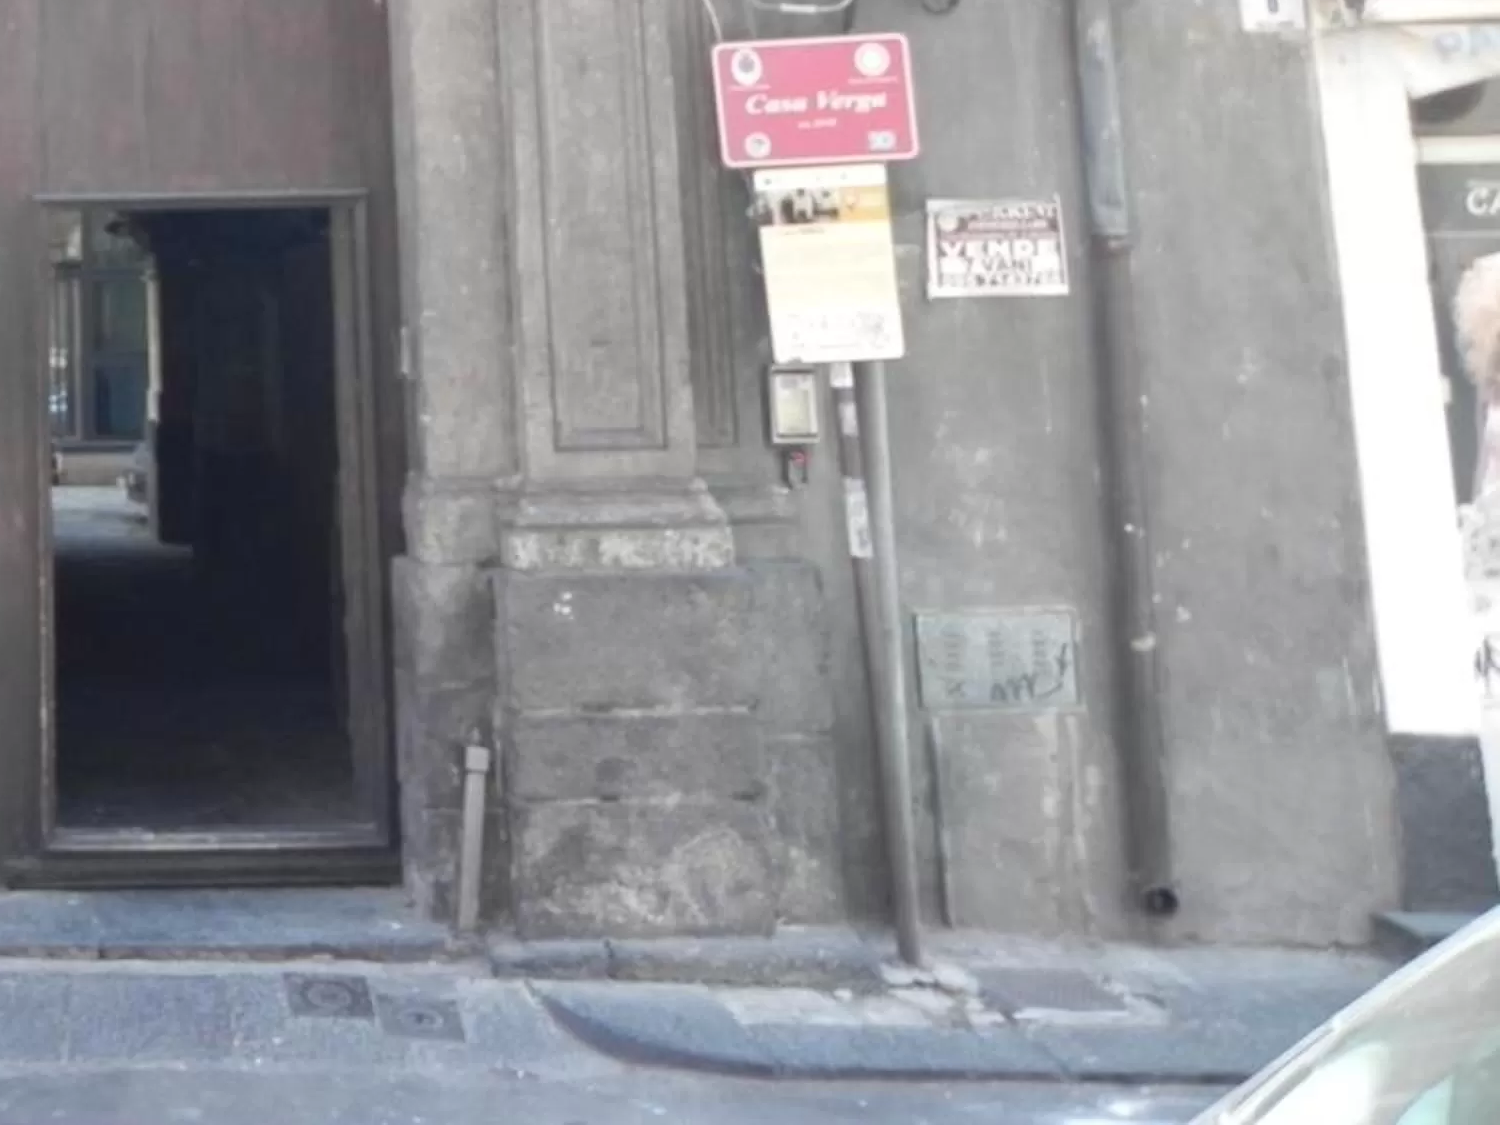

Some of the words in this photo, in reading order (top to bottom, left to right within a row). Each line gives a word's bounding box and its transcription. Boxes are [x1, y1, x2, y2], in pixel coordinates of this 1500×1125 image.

[745, 93, 809, 115] Casa
[815, 89, 888, 115] Verga
[940, 240, 1057, 260] VENDE
